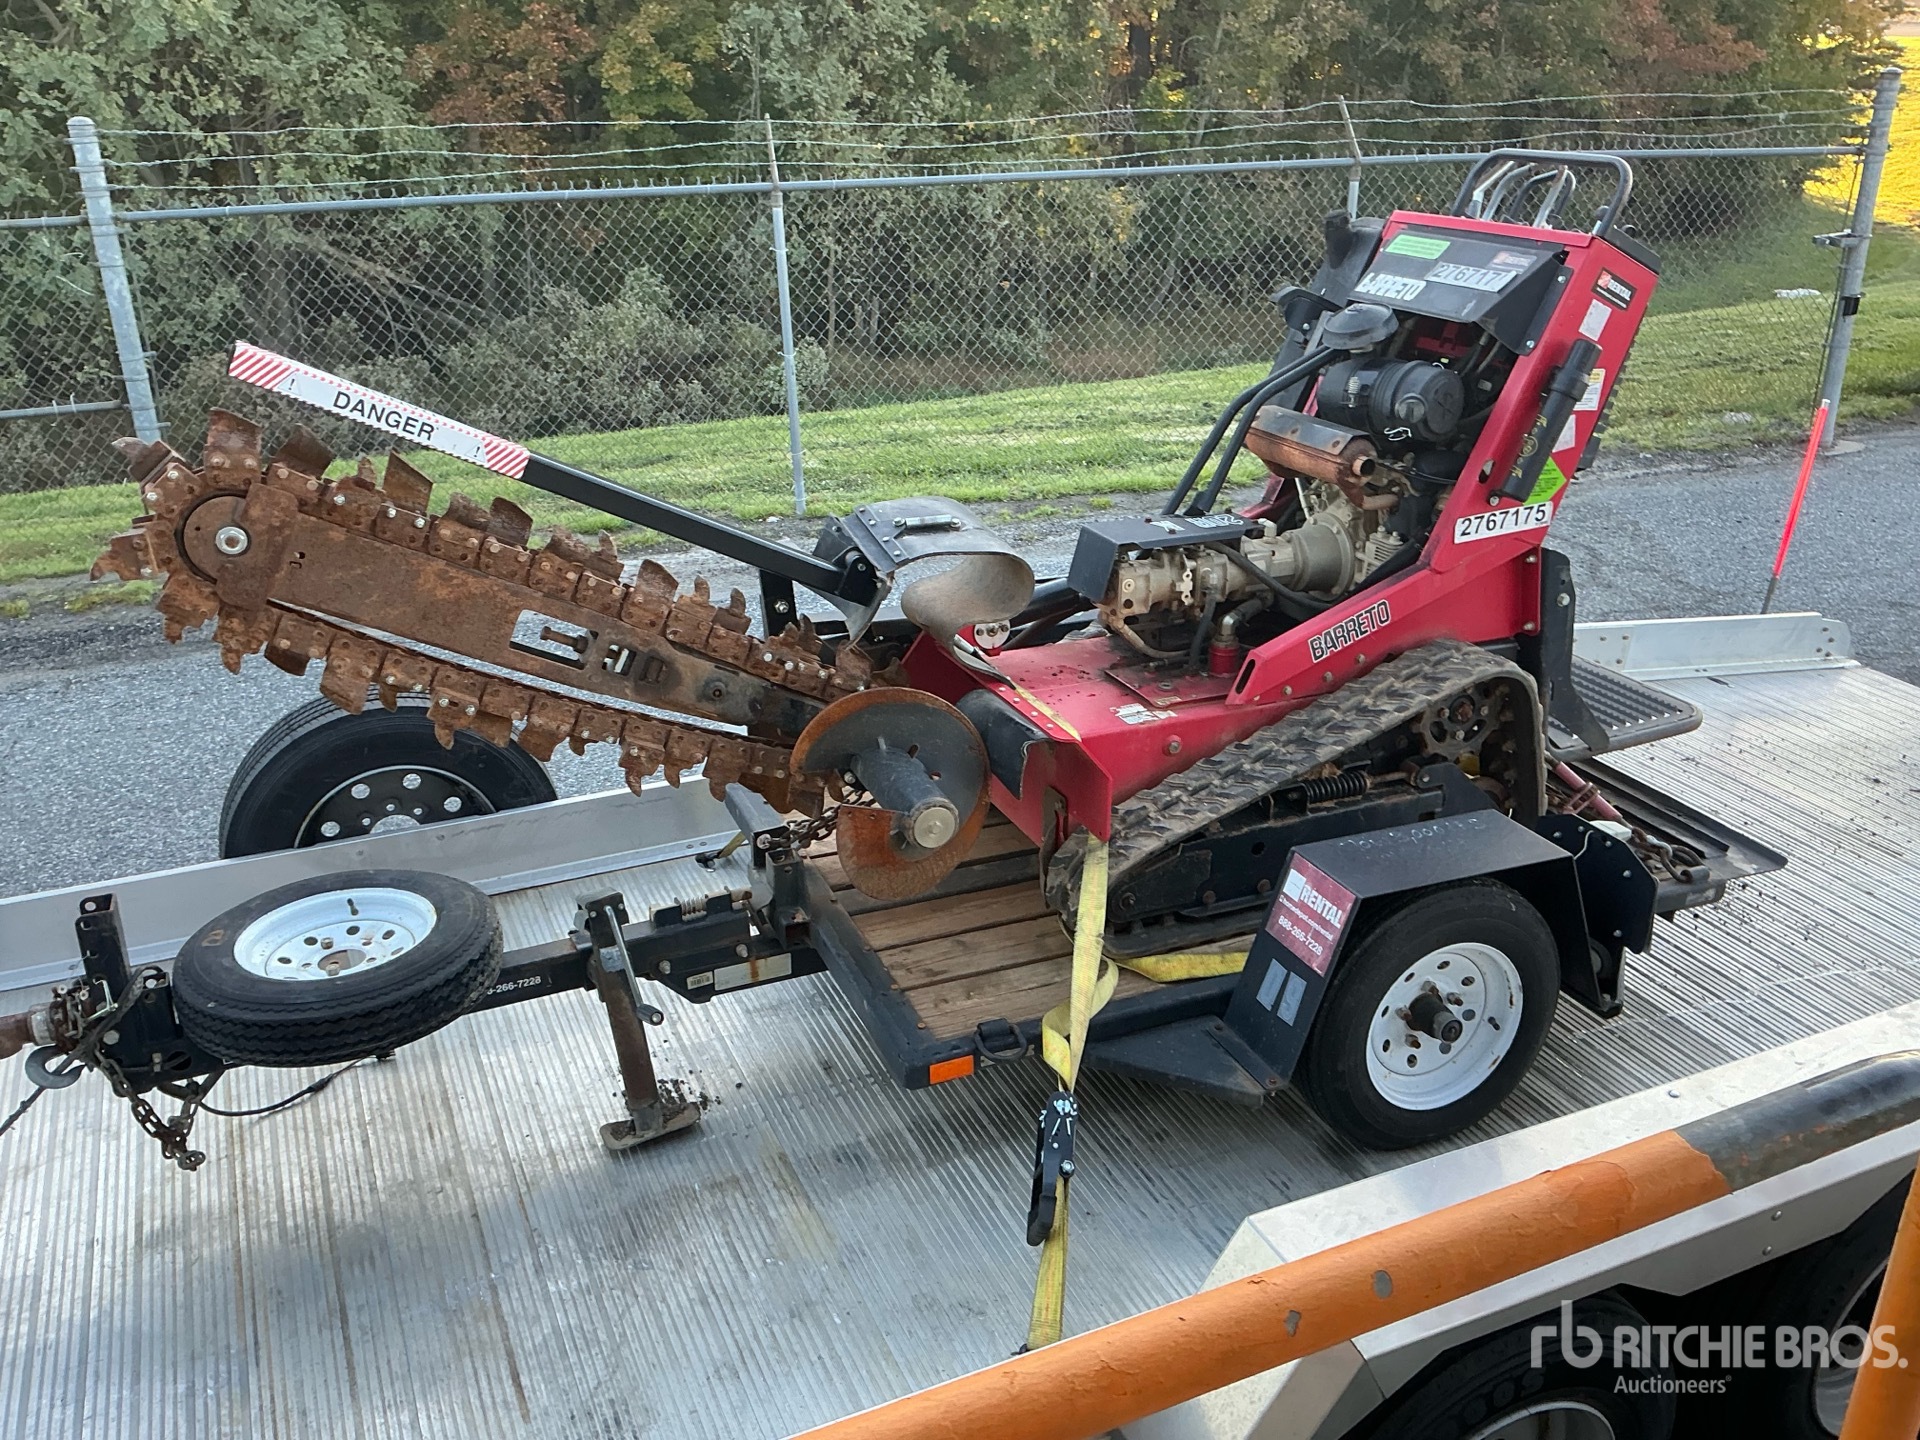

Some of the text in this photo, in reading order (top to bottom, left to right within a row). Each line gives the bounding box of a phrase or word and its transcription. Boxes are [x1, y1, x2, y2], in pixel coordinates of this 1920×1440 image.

[333, 391, 435, 441] DANGER
[1460, 503, 1546, 537] 2767175
[1308, 599, 1391, 663] BARRETO
[1300, 884, 1343, 928] RENTAL
